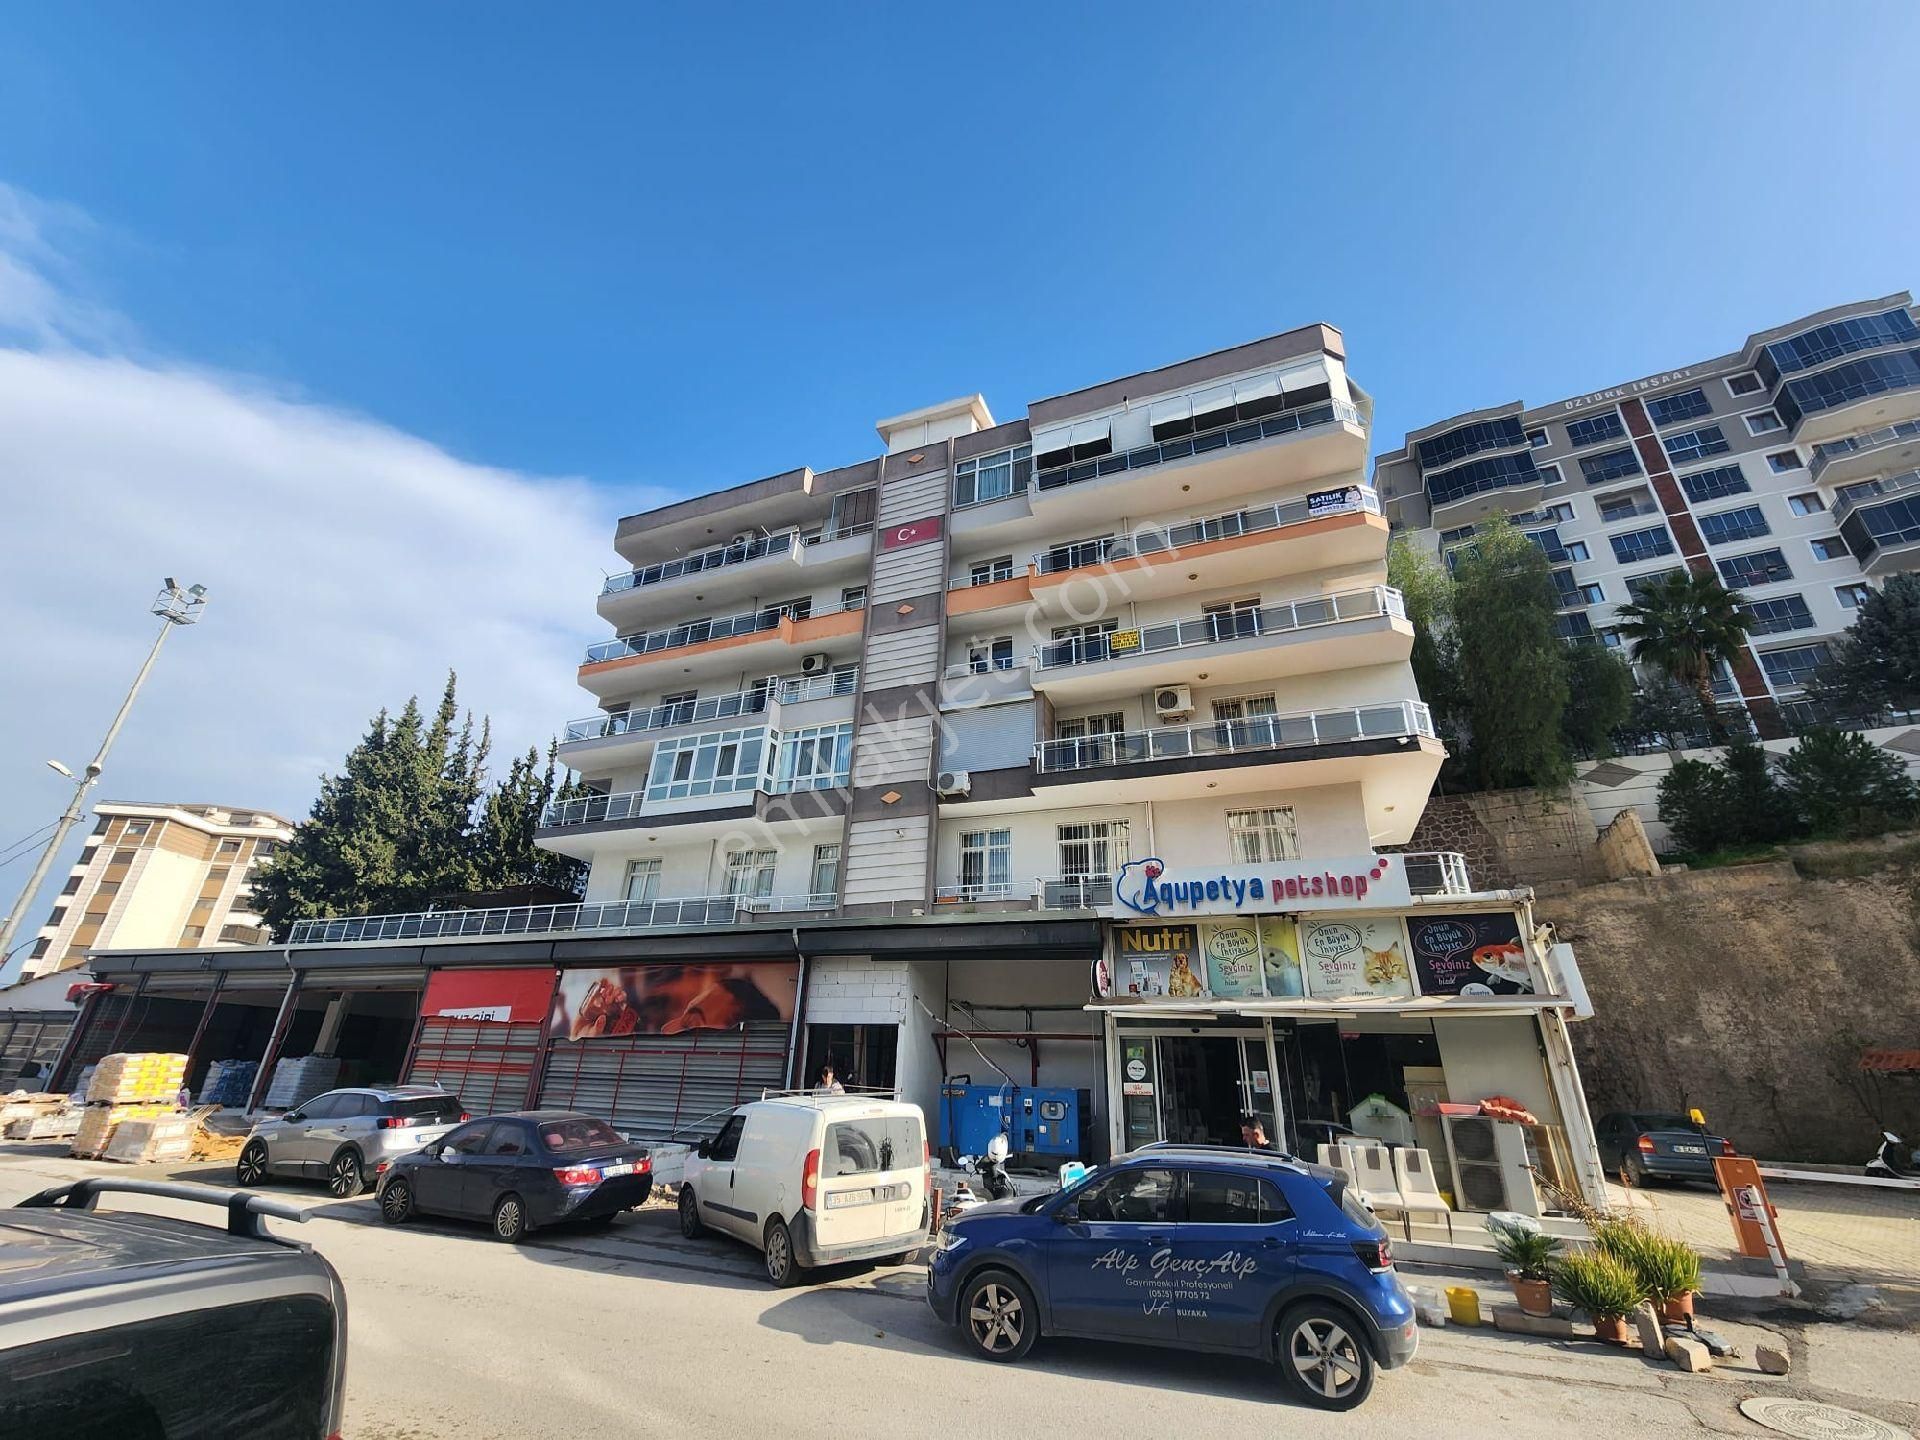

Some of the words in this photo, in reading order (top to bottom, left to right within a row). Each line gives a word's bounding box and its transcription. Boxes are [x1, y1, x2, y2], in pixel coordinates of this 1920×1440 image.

[1309, 491, 1342, 505] SATILIK
[1143, 875, 1264, 911] Aqupetya
[1272, 872, 1368, 905] petshop
[1121, 927, 1191, 952] Nutri
[1314, 938, 1324, 947] En
[1424, 936, 1435, 945] En
[1091, 1248, 1140, 1276] Alp
[1150, 1248, 1258, 1280] GençAlp
[1125, 1278, 1179, 1288] Gayrimenkul
[1180, 1280, 1233, 1291] Profesyoneli
